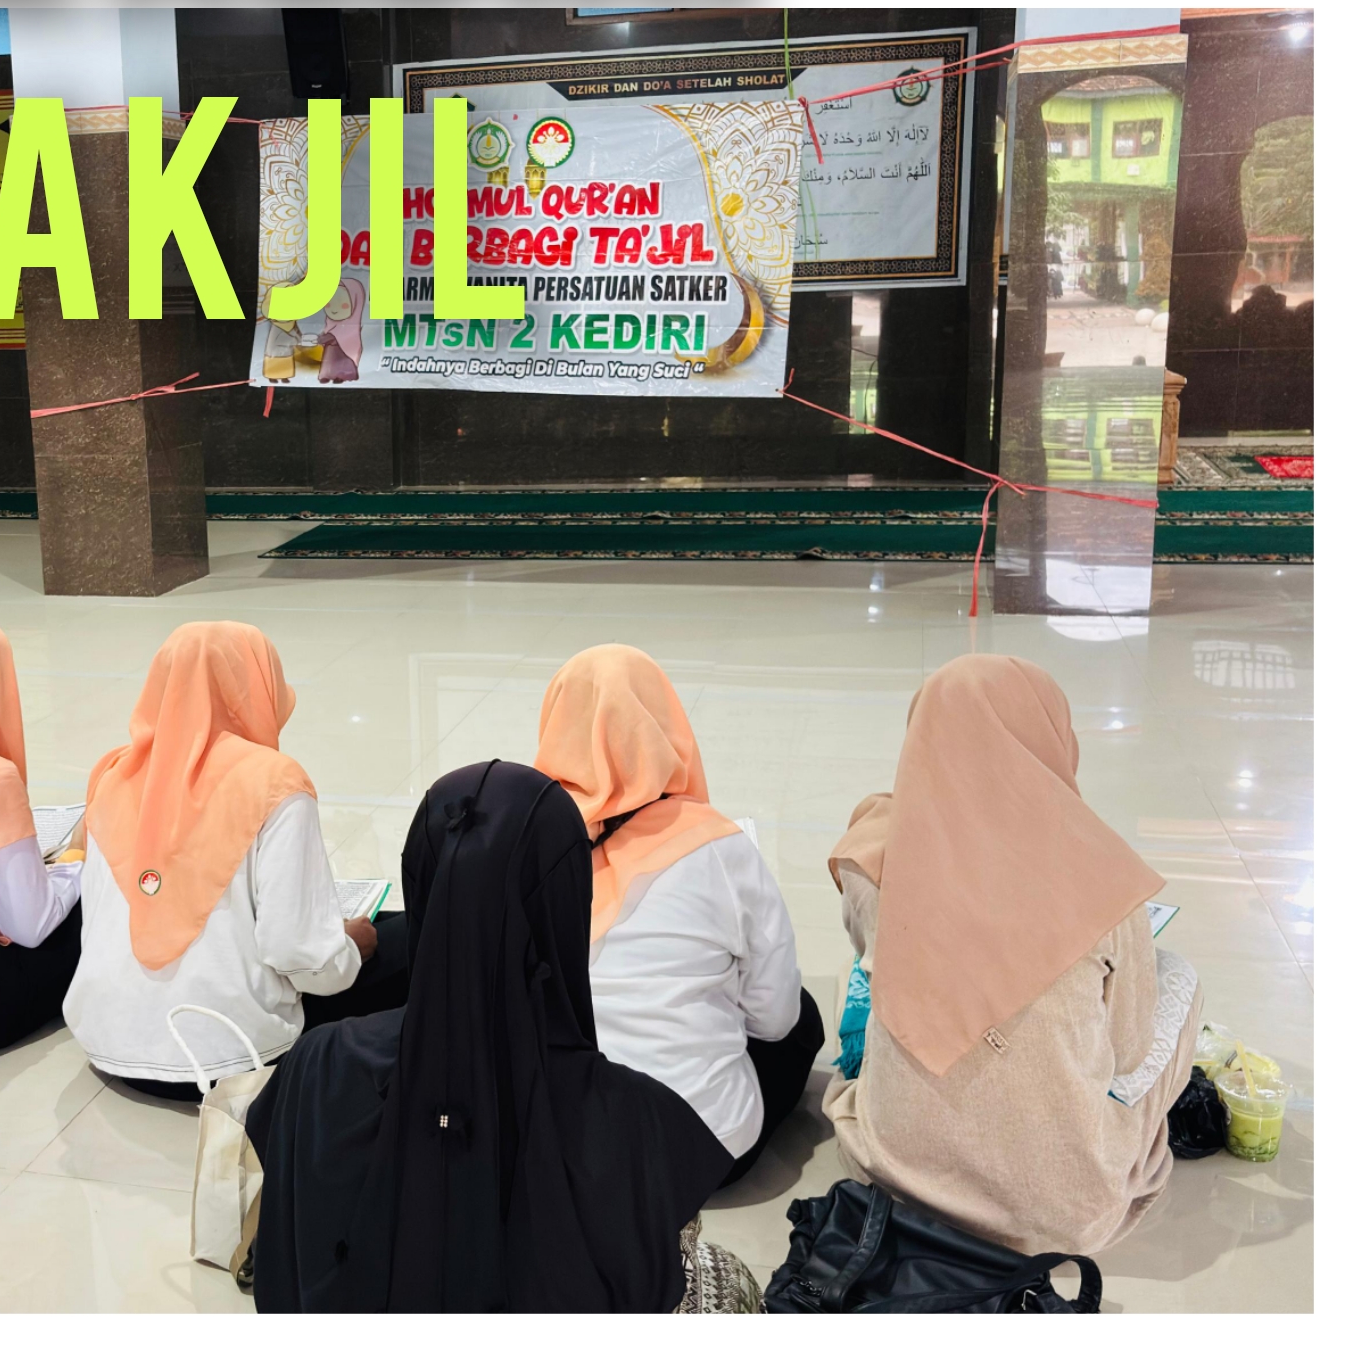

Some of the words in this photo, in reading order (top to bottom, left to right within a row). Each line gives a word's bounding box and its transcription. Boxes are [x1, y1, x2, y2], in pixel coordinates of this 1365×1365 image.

[569, 83, 609, 95] DZIKIR
[614, 82, 638, 93] DAN
[644, 80, 671, 91] DO'A
[677, 77, 731, 89] SETELAH
[737, 74, 785, 86] SHOLAT
[542, 181, 660, 219] QUR'AN
[534, 277, 645, 301] PERSATUAN
[651, 274, 727, 301] SATKER
[384, 313, 495, 348] MTsN
[510, 313, 534, 348] 2
[550, 312, 707, 352] KEDIRI
[391, 358, 465, 376] Indahnya
[469, 360, 532, 378] Berbagi
[535, 362, 554, 376] Di
[556, 363, 602, 377] Bulan
[608, 364, 651, 380] Yang
[654, 365, 691, 379] Suci
